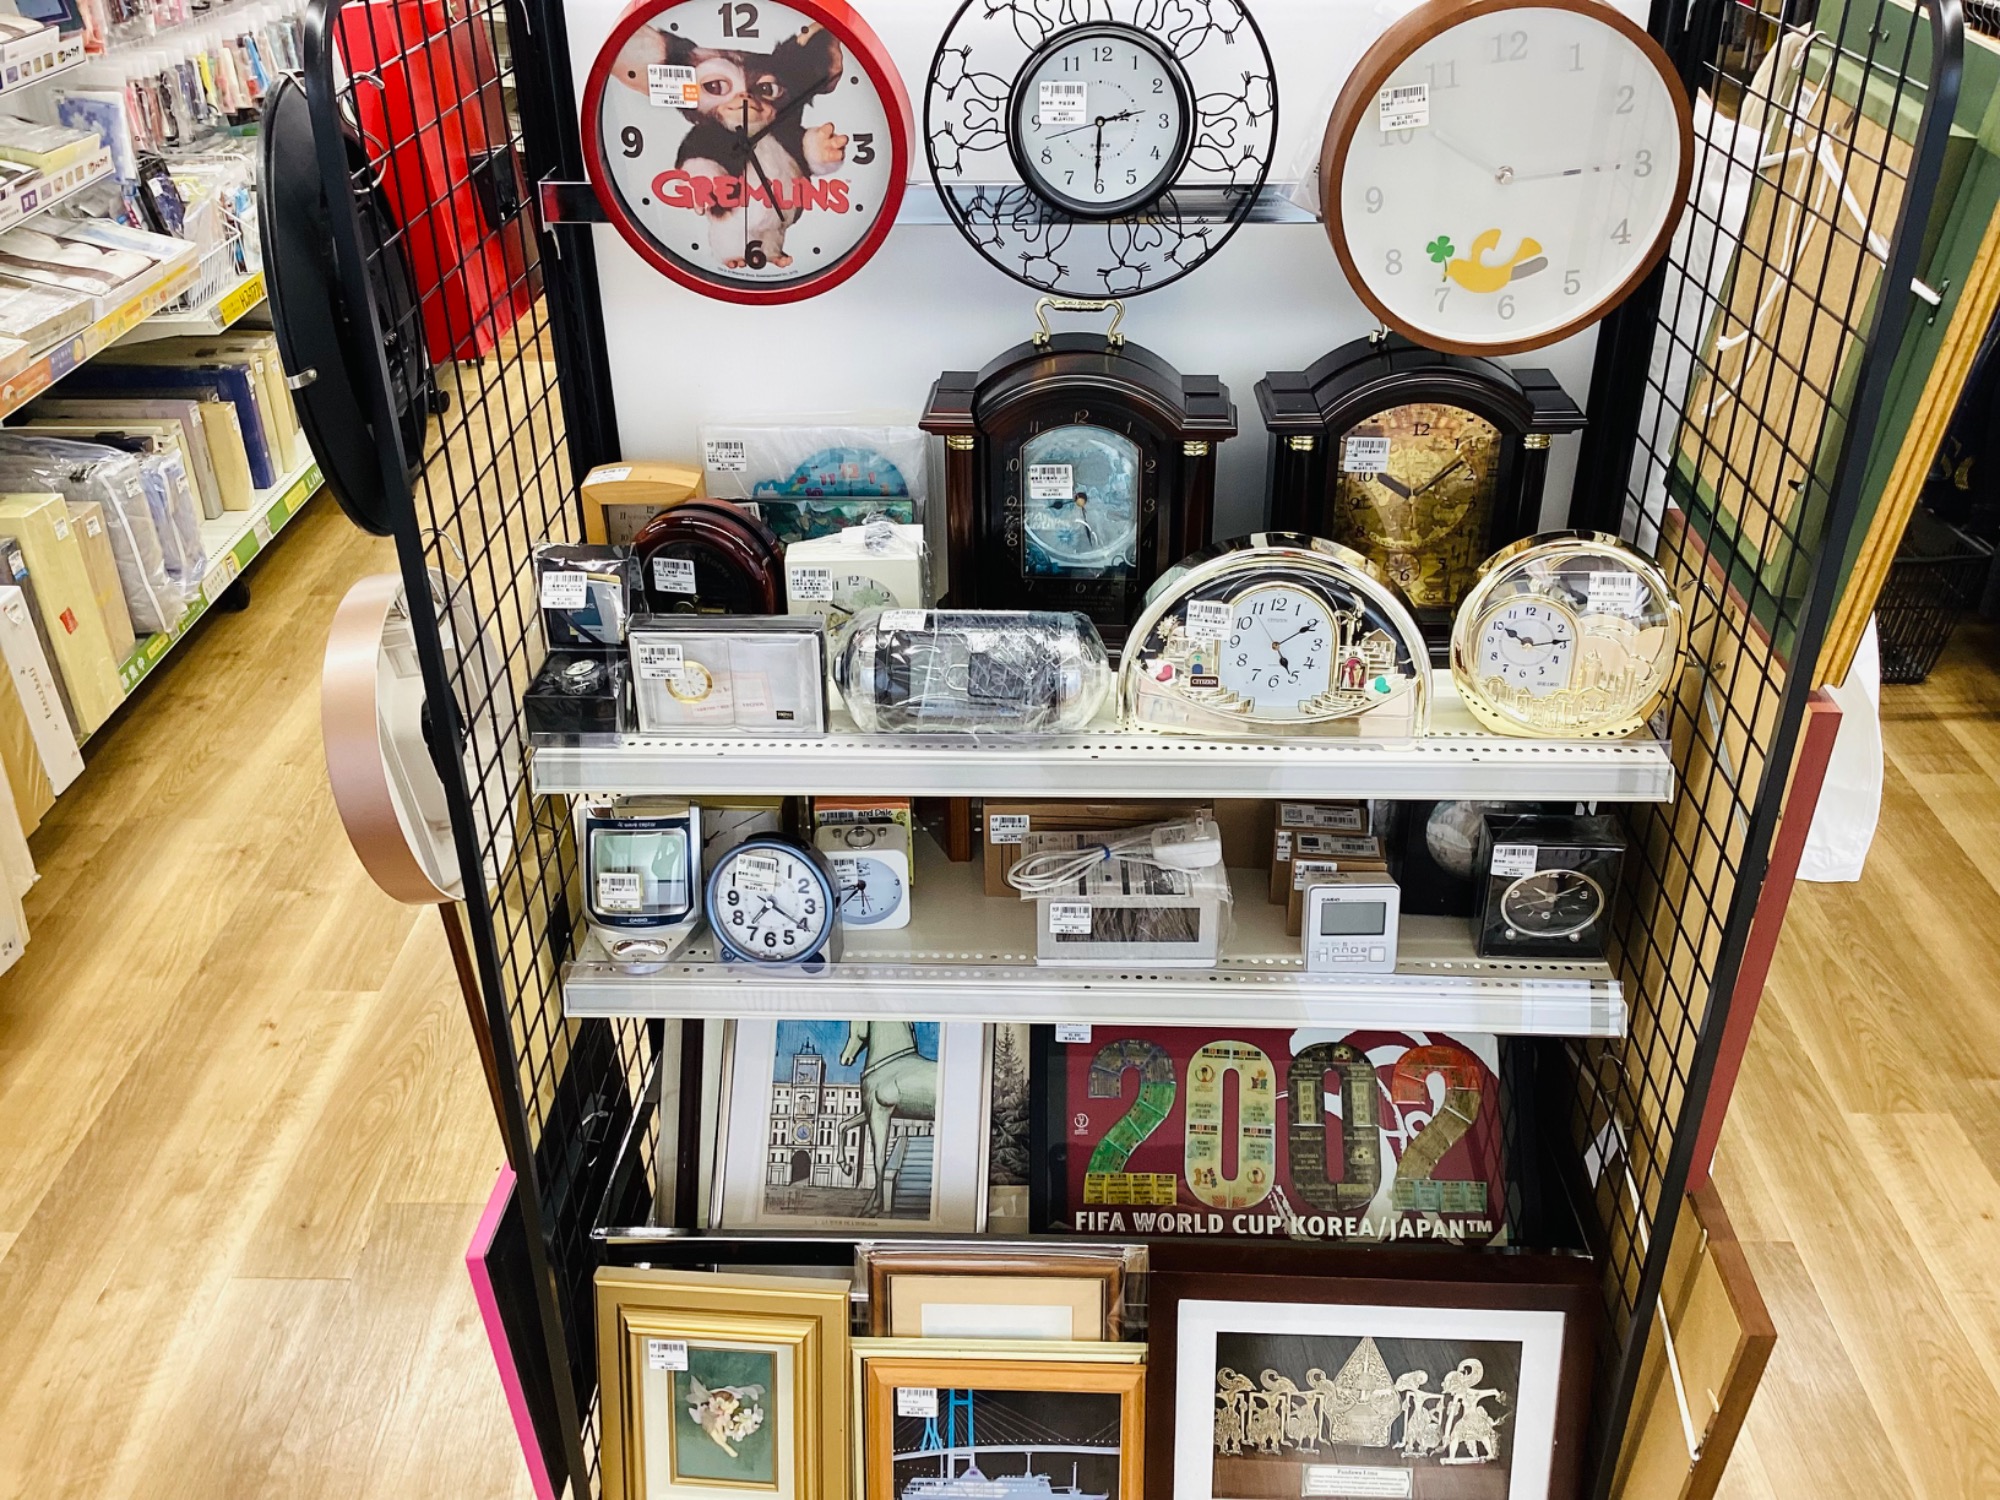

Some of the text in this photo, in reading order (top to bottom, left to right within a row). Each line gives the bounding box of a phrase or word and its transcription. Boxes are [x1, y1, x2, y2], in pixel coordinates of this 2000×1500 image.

[718, 2, 759, 38] 12
[1092, 47, 1113, 62] 12
[1490, 30, 1528, 64] 12
[1062, 56, 1080, 71] 11
[1132, 55, 1138, 70] 1
[1569, 43, 1584, 72] 1
[1152, 78, 1163, 94] 2
[1615, 86, 1636, 114] 2
[1031, 115, 1042, 133] 9
[1158, 114, 1169, 129] 3
[620, 126, 644, 158] 9
[852, 133, 875, 164] 3
[1041, 149, 1052, 164] 8
[1150, 146, 1162, 160] 4
[1634, 150, 1653, 178] 3
[1064, 171, 1074, 185] 7
[1126, 169, 1137, 185] 5
[651, 169, 849, 214] GREMLINS
[1094, 179, 1104, 194] 6
[1364, 186, 1384, 214] 9
[1610, 218, 1632, 245] 4
[746, 240, 766, 270] 6
[1385, 250, 1403, 276] 8
[1564, 270, 1581, 296] 5
[1434, 288, 1450, 312] 7
[1498, 295, 1515, 320] 6
[1074, 409, 1089, 424] 12
[1029, 420, 1040, 433] 11
[1126, 421, 1132, 434] 1
[1413, 423, 1430, 436] 12
[1006, 459, 1020, 472] 10
[1145, 460, 1156, 473] 2
[1464, 468, 1474, 480] 2
[1145, 500, 1156, 512] 3
[1006, 533, 1018, 546] 8
[1400, 569, 1410, 581] 6
[1024, 581, 1036, 592] 7
[1076, 582, 1086, 594] 6
[1252, 602, 1264, 615] 11
[1270, 598, 1288, 612] 12
[1295, 603, 1301, 616] 1
[1526, 607, 1536, 616] 12
[1508, 610, 1517, 620] 11
[1547, 612, 1552, 622] 1
[1236, 616, 1252, 630] 10
[1306, 618, 1318, 632] 2
[1493, 621, 1504, 631] 10
[1557, 624, 1564, 633] 2
[1229, 636, 1241, 648] 9
[1311, 638, 1323, 651] 3
[1236, 653, 1248, 668] 8
[1303, 656, 1316, 670] 4
[1490, 652, 1498, 660] 8
[1252, 668, 1262, 682] 7
[1502, 664, 1510, 674] 7
[1518, 669, 1526, 678] 6
[1268, 674, 1280, 688] 6
[1288, 670, 1300, 684] 5
[788, 864, 792, 879] 1
[798, 878, 810, 894] 2
[728, 890, 740, 906] 9
[804, 898, 816, 914] 3
[732, 910, 744, 926] 8
[796, 918, 810, 932] 4
[746, 926, 758, 941] 7
[764, 932, 776, 948] 6
[783, 930, 794, 946] 5
[1083, 1039, 1487, 1213] 2002
[1076, 1212, 1126, 1232] FIFA
[1133, 1212, 1224, 1233] WORLD
[1232, 1214, 1282, 1234] CUP
